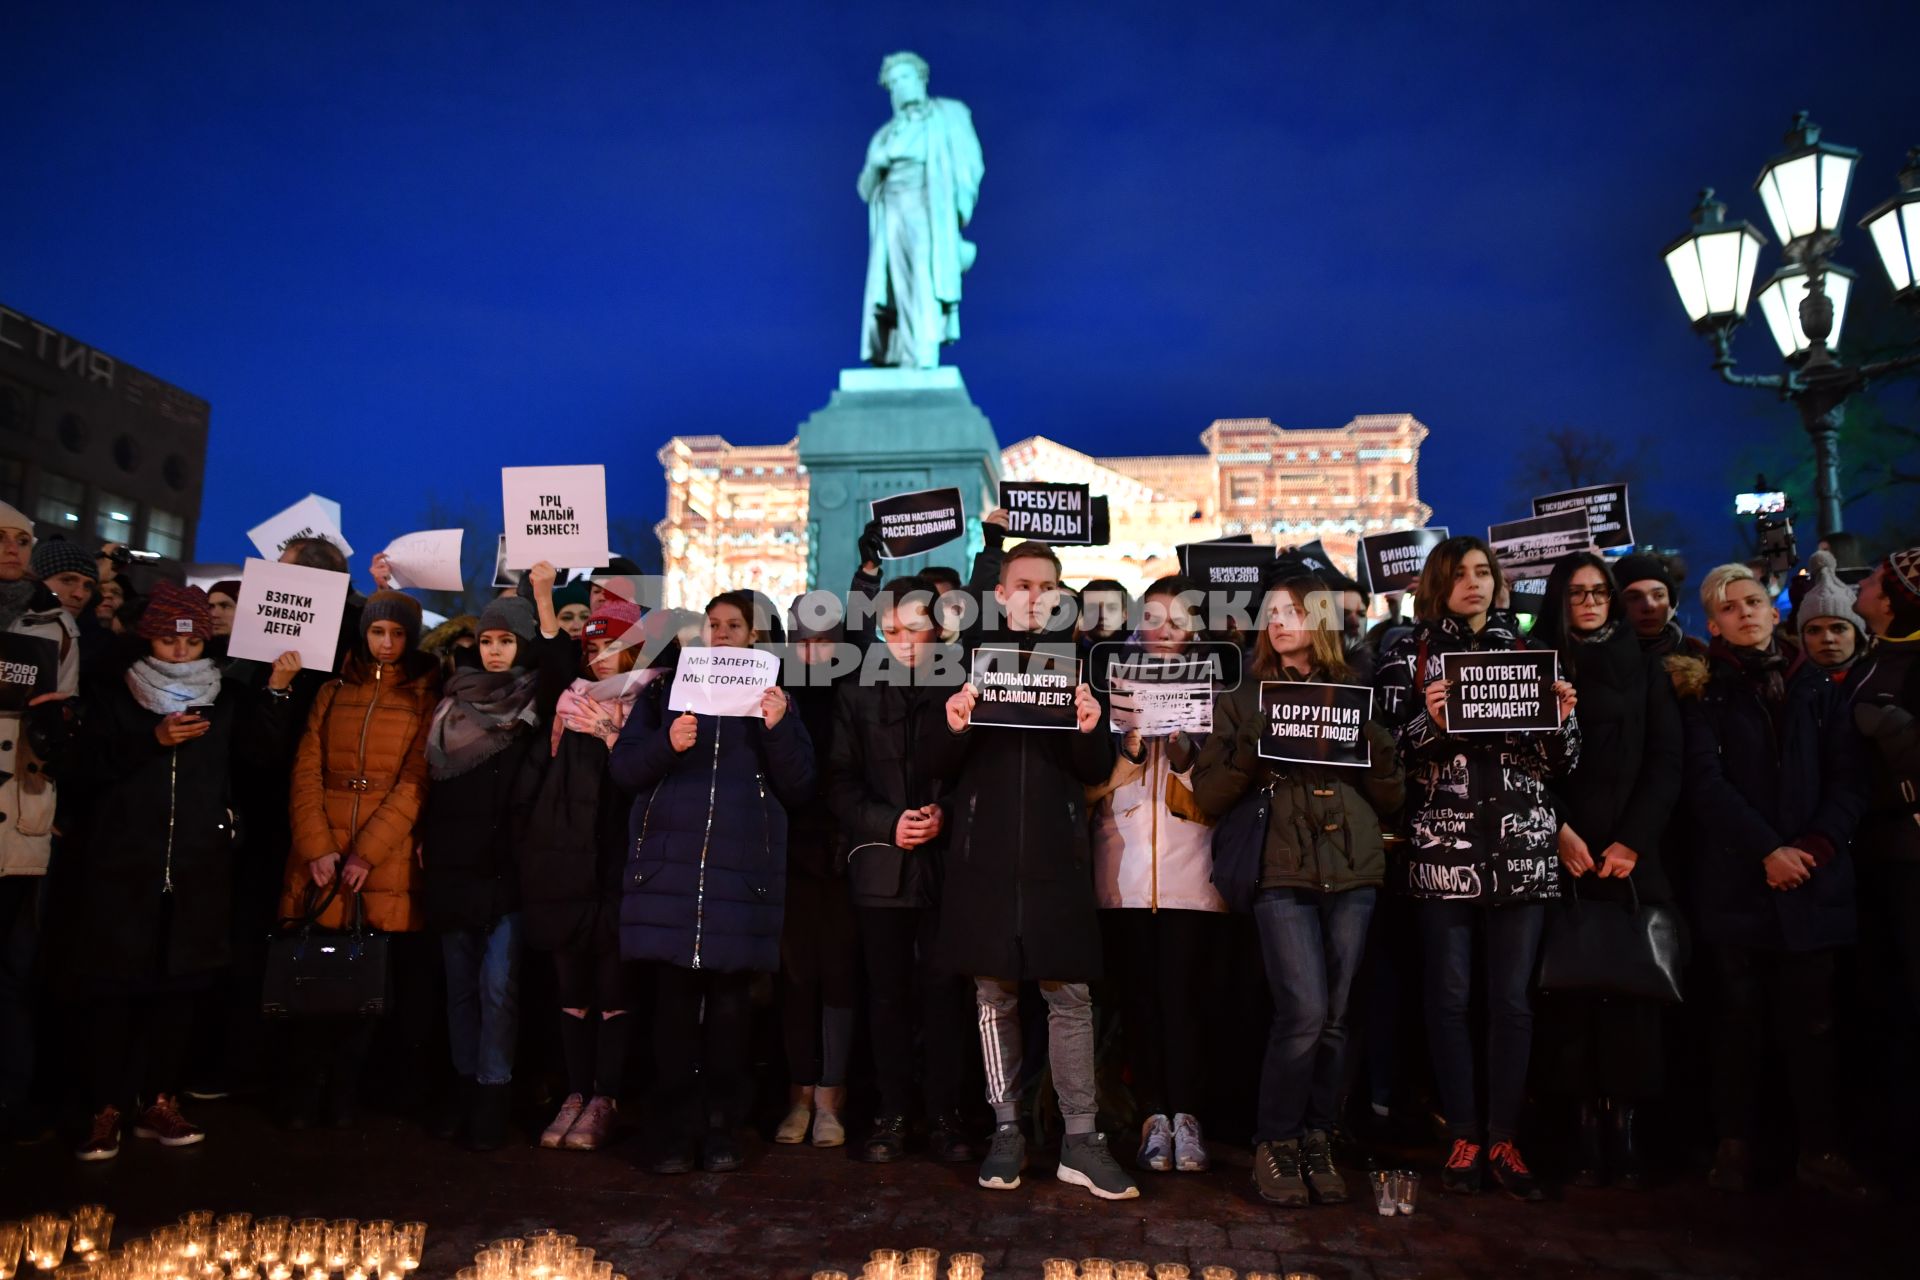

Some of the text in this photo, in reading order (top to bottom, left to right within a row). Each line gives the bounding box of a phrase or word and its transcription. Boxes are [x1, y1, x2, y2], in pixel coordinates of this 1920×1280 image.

[539, 495, 562, 508] ТРЦ
[1007, 490, 1081, 510] ТРЕБУЕМ
[530, 507, 574, 521] МАЛЫЙ
[881, 507, 955, 524] ТРЕБУЕМ НАСТОЯЩЕГО
[526, 523, 580, 536] БИЗНЕС?!
[882, 519, 956, 538] РАССЛЕДОВАНИЯ
[1008, 511, 1082, 535] ПРАВДЫ
[1209, 566, 1259, 574] КЕМЕРОВО
[1210, 573, 1259, 583] 25.03.2018
[1382, 563, 1391, 577] В
[265, 590, 313, 608] ВЗЯТКИ
[257, 604, 315, 624] УБИВАЮТ
[264, 621, 301, 637] ДЕТЕЙ
[687, 656, 769, 670] МЫ ЗАПЕРТЫ,
[682, 674, 767, 686] МЫ СГОРАЕМ!
[983, 672, 1067, 688] СКОЛЬКО ЖЕРТВ
[1460, 666, 1483, 682] КТО
[1486, 664, 1541, 682] ОТВЕТИТ,
[983, 688, 1072, 706] НА САМОМ ДЕЛЕ?
[1461, 683, 1539, 700] ГОСПОДИН
[1272, 704, 1360, 724] КОРРУПЦИЯ
[1462, 701, 1540, 719] ПРЕЗИДЕНТ?
[1271, 723, 1359, 742] УБИВАЕТ ЛЮДЕЙ
[1434, 820, 1466, 833] MOM
[1507, 858, 1533, 872] DEAR
